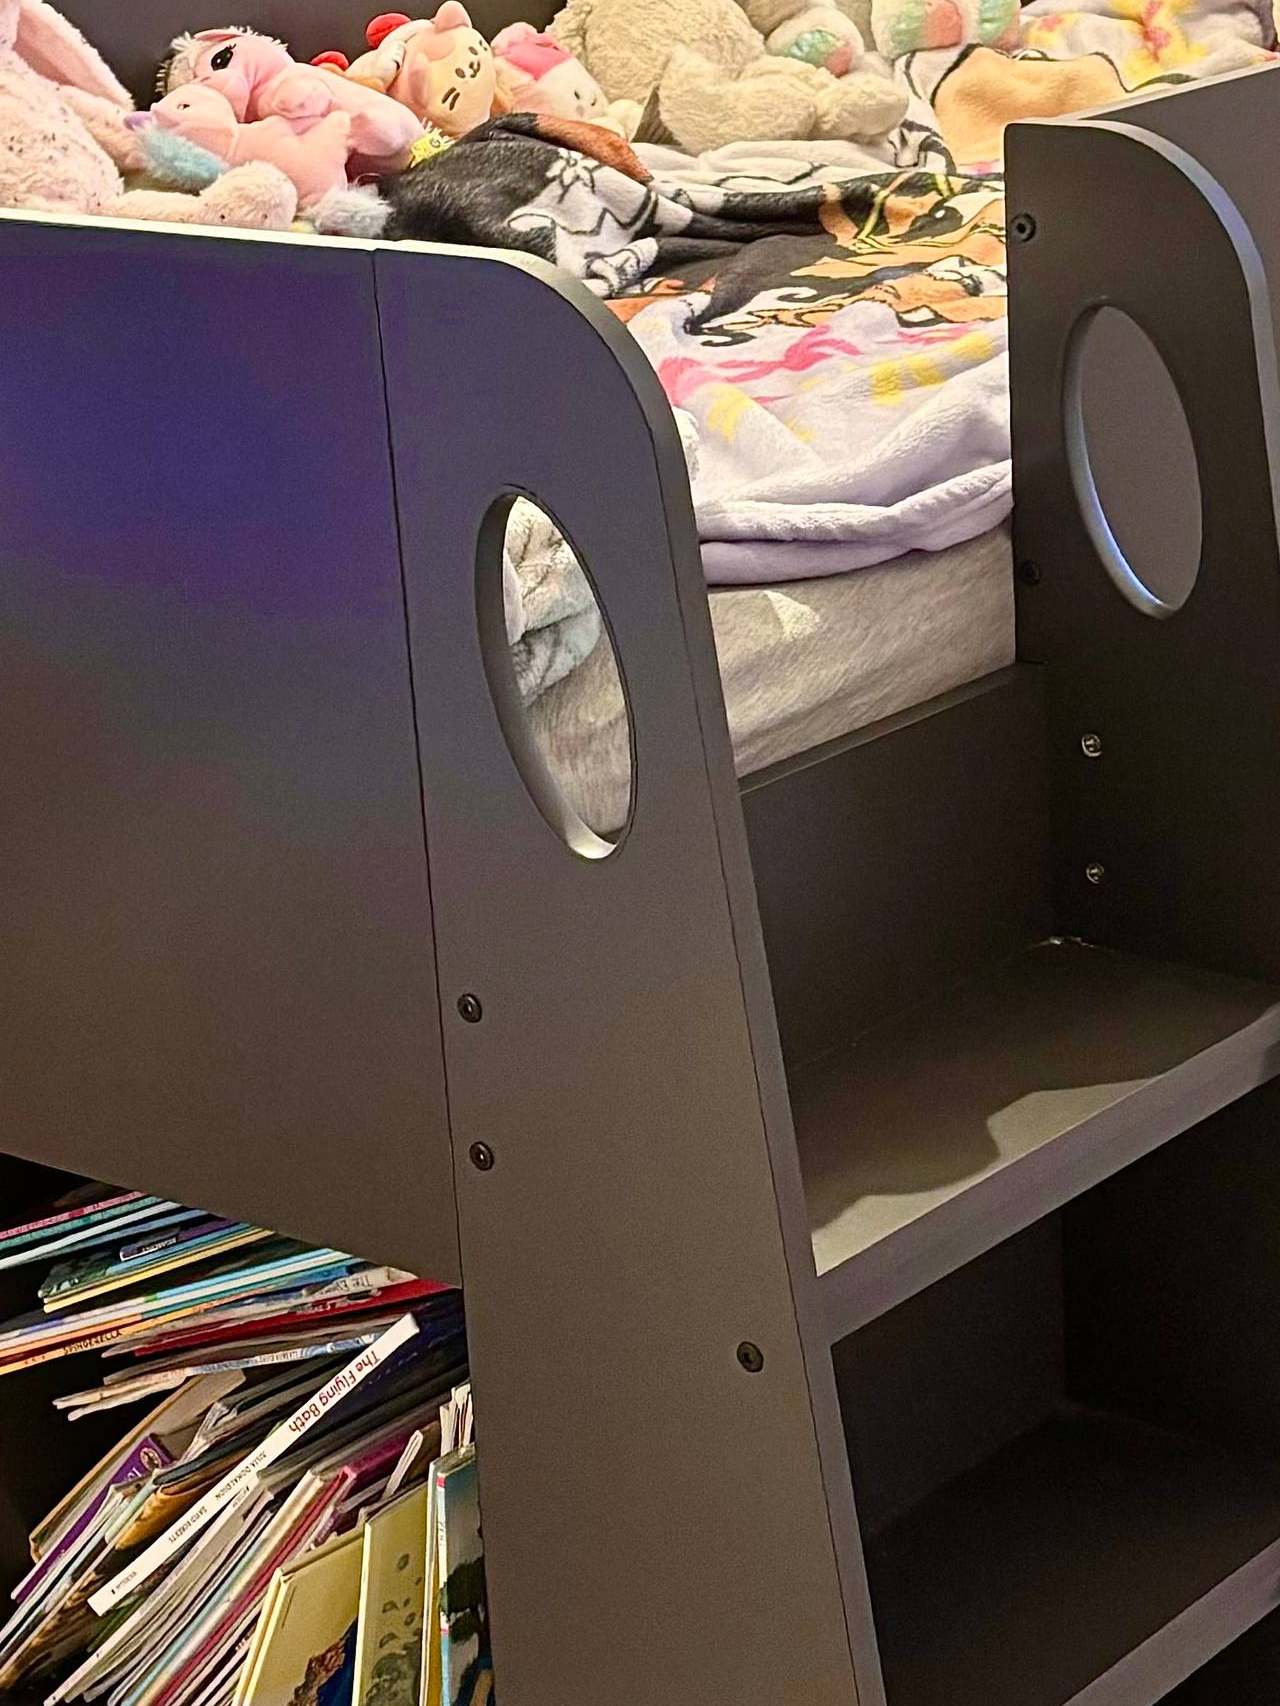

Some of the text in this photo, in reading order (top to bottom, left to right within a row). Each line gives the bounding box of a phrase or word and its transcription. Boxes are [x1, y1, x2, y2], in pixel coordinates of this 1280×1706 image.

[288, 1350, 382, 1433] The Flying Bath
